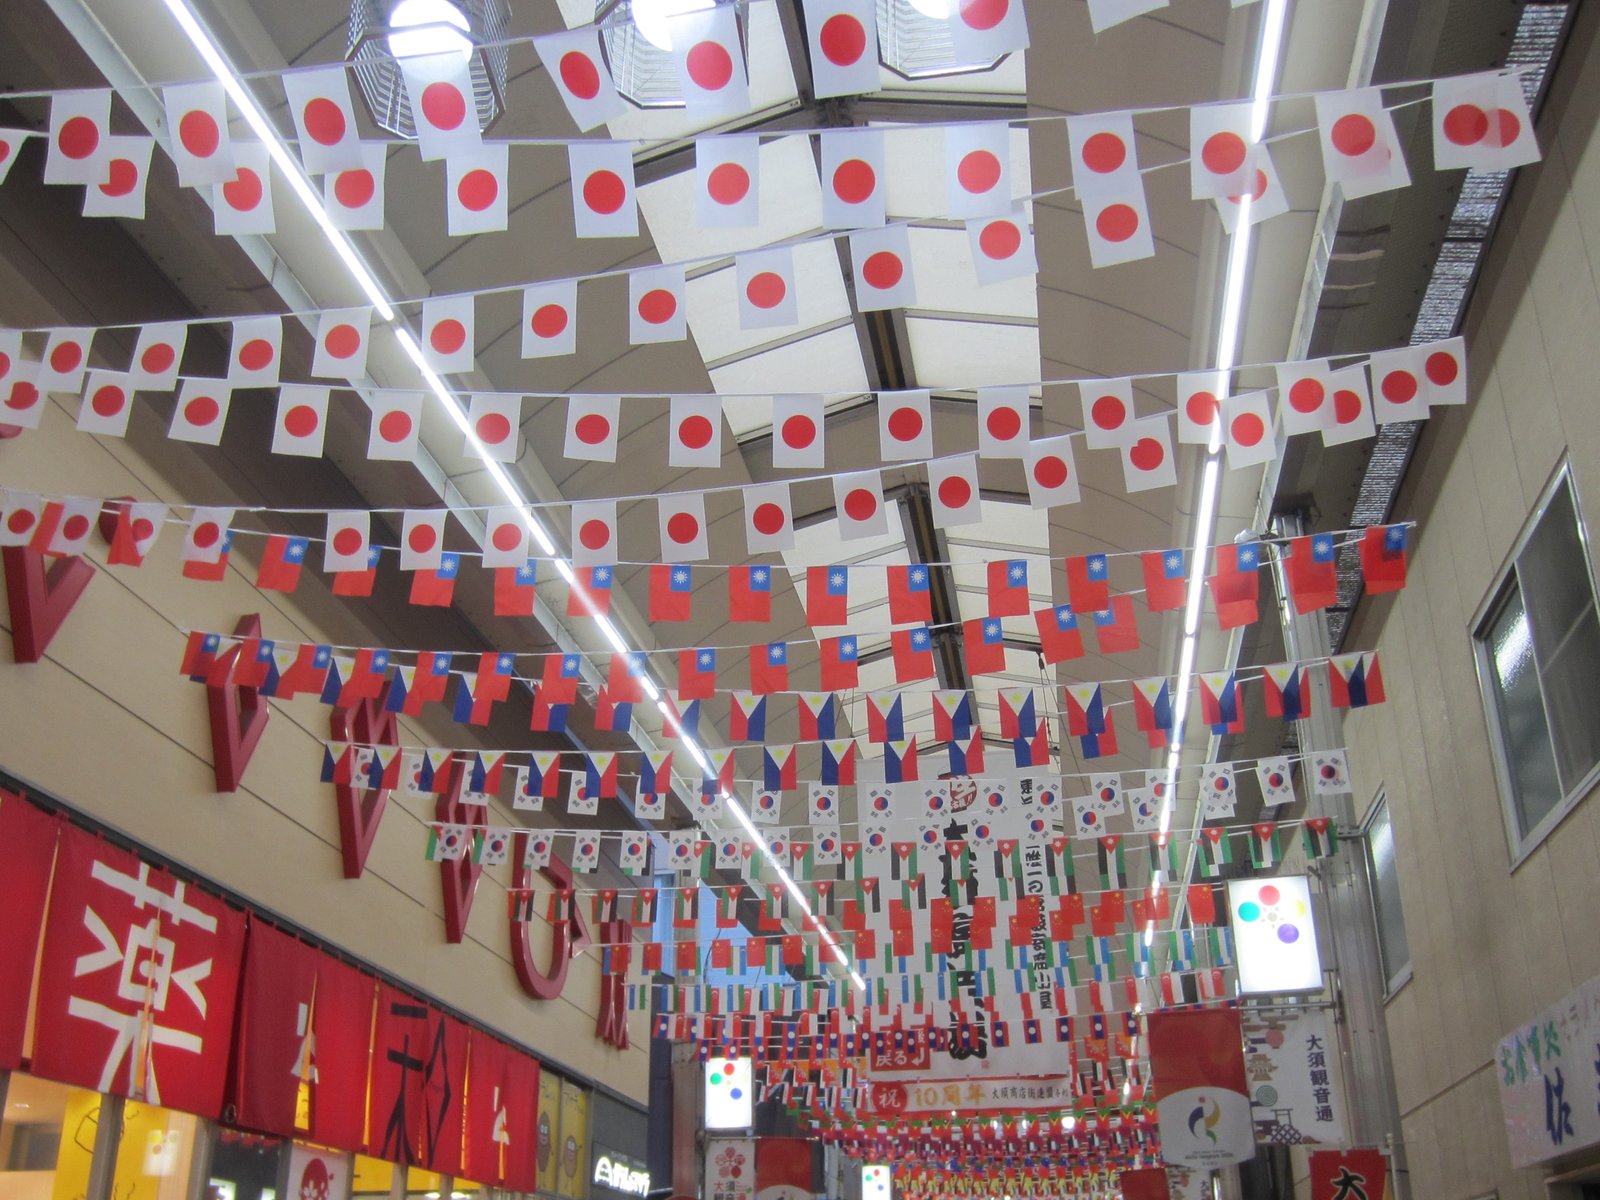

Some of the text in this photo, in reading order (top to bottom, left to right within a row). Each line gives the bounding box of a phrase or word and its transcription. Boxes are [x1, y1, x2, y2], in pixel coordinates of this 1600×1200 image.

[875, 1049, 908, 1067] 戻る
[1306, 1034, 1334, 1123] 大須観音通
[879, 1086, 901, 1109] 祝
[913, 1083, 986, 1107] 10周年
